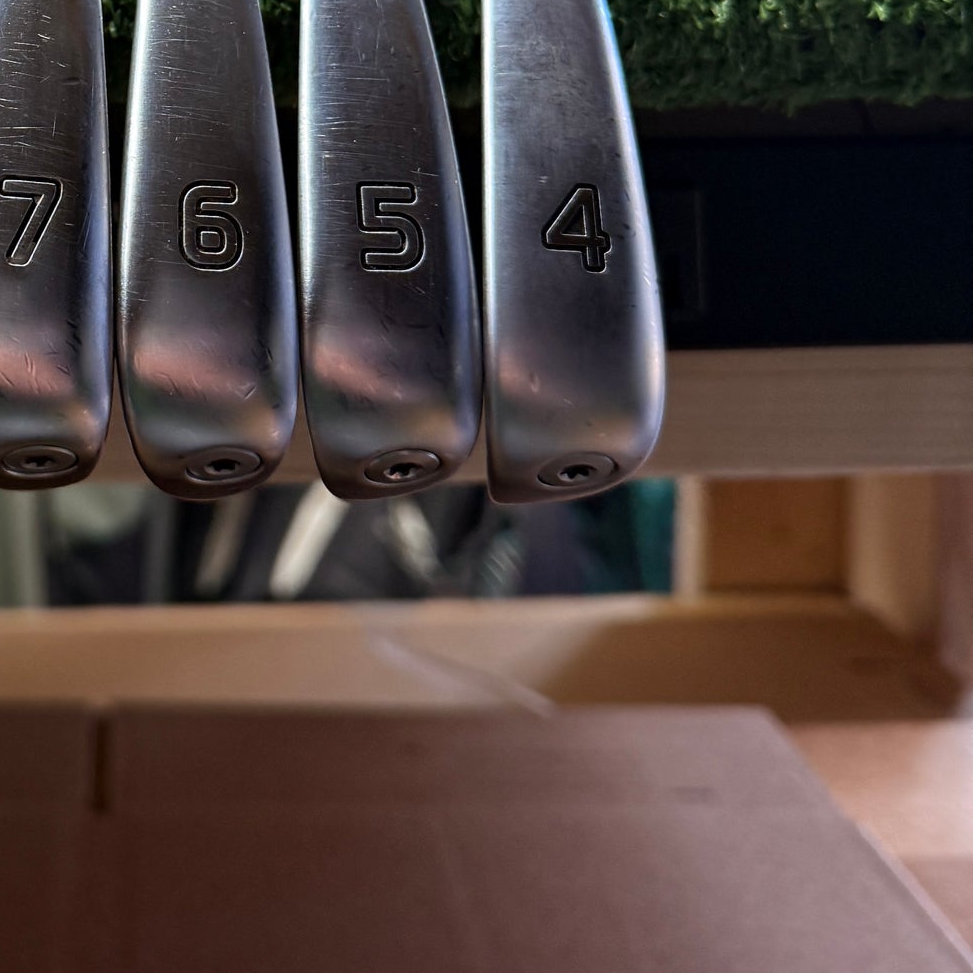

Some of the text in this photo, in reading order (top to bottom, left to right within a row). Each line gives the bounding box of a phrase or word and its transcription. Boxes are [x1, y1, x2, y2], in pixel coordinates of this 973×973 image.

[177, 179, 244, 272] 6
[356, 181, 426, 272] 5
[541, 182, 612, 273] 4
